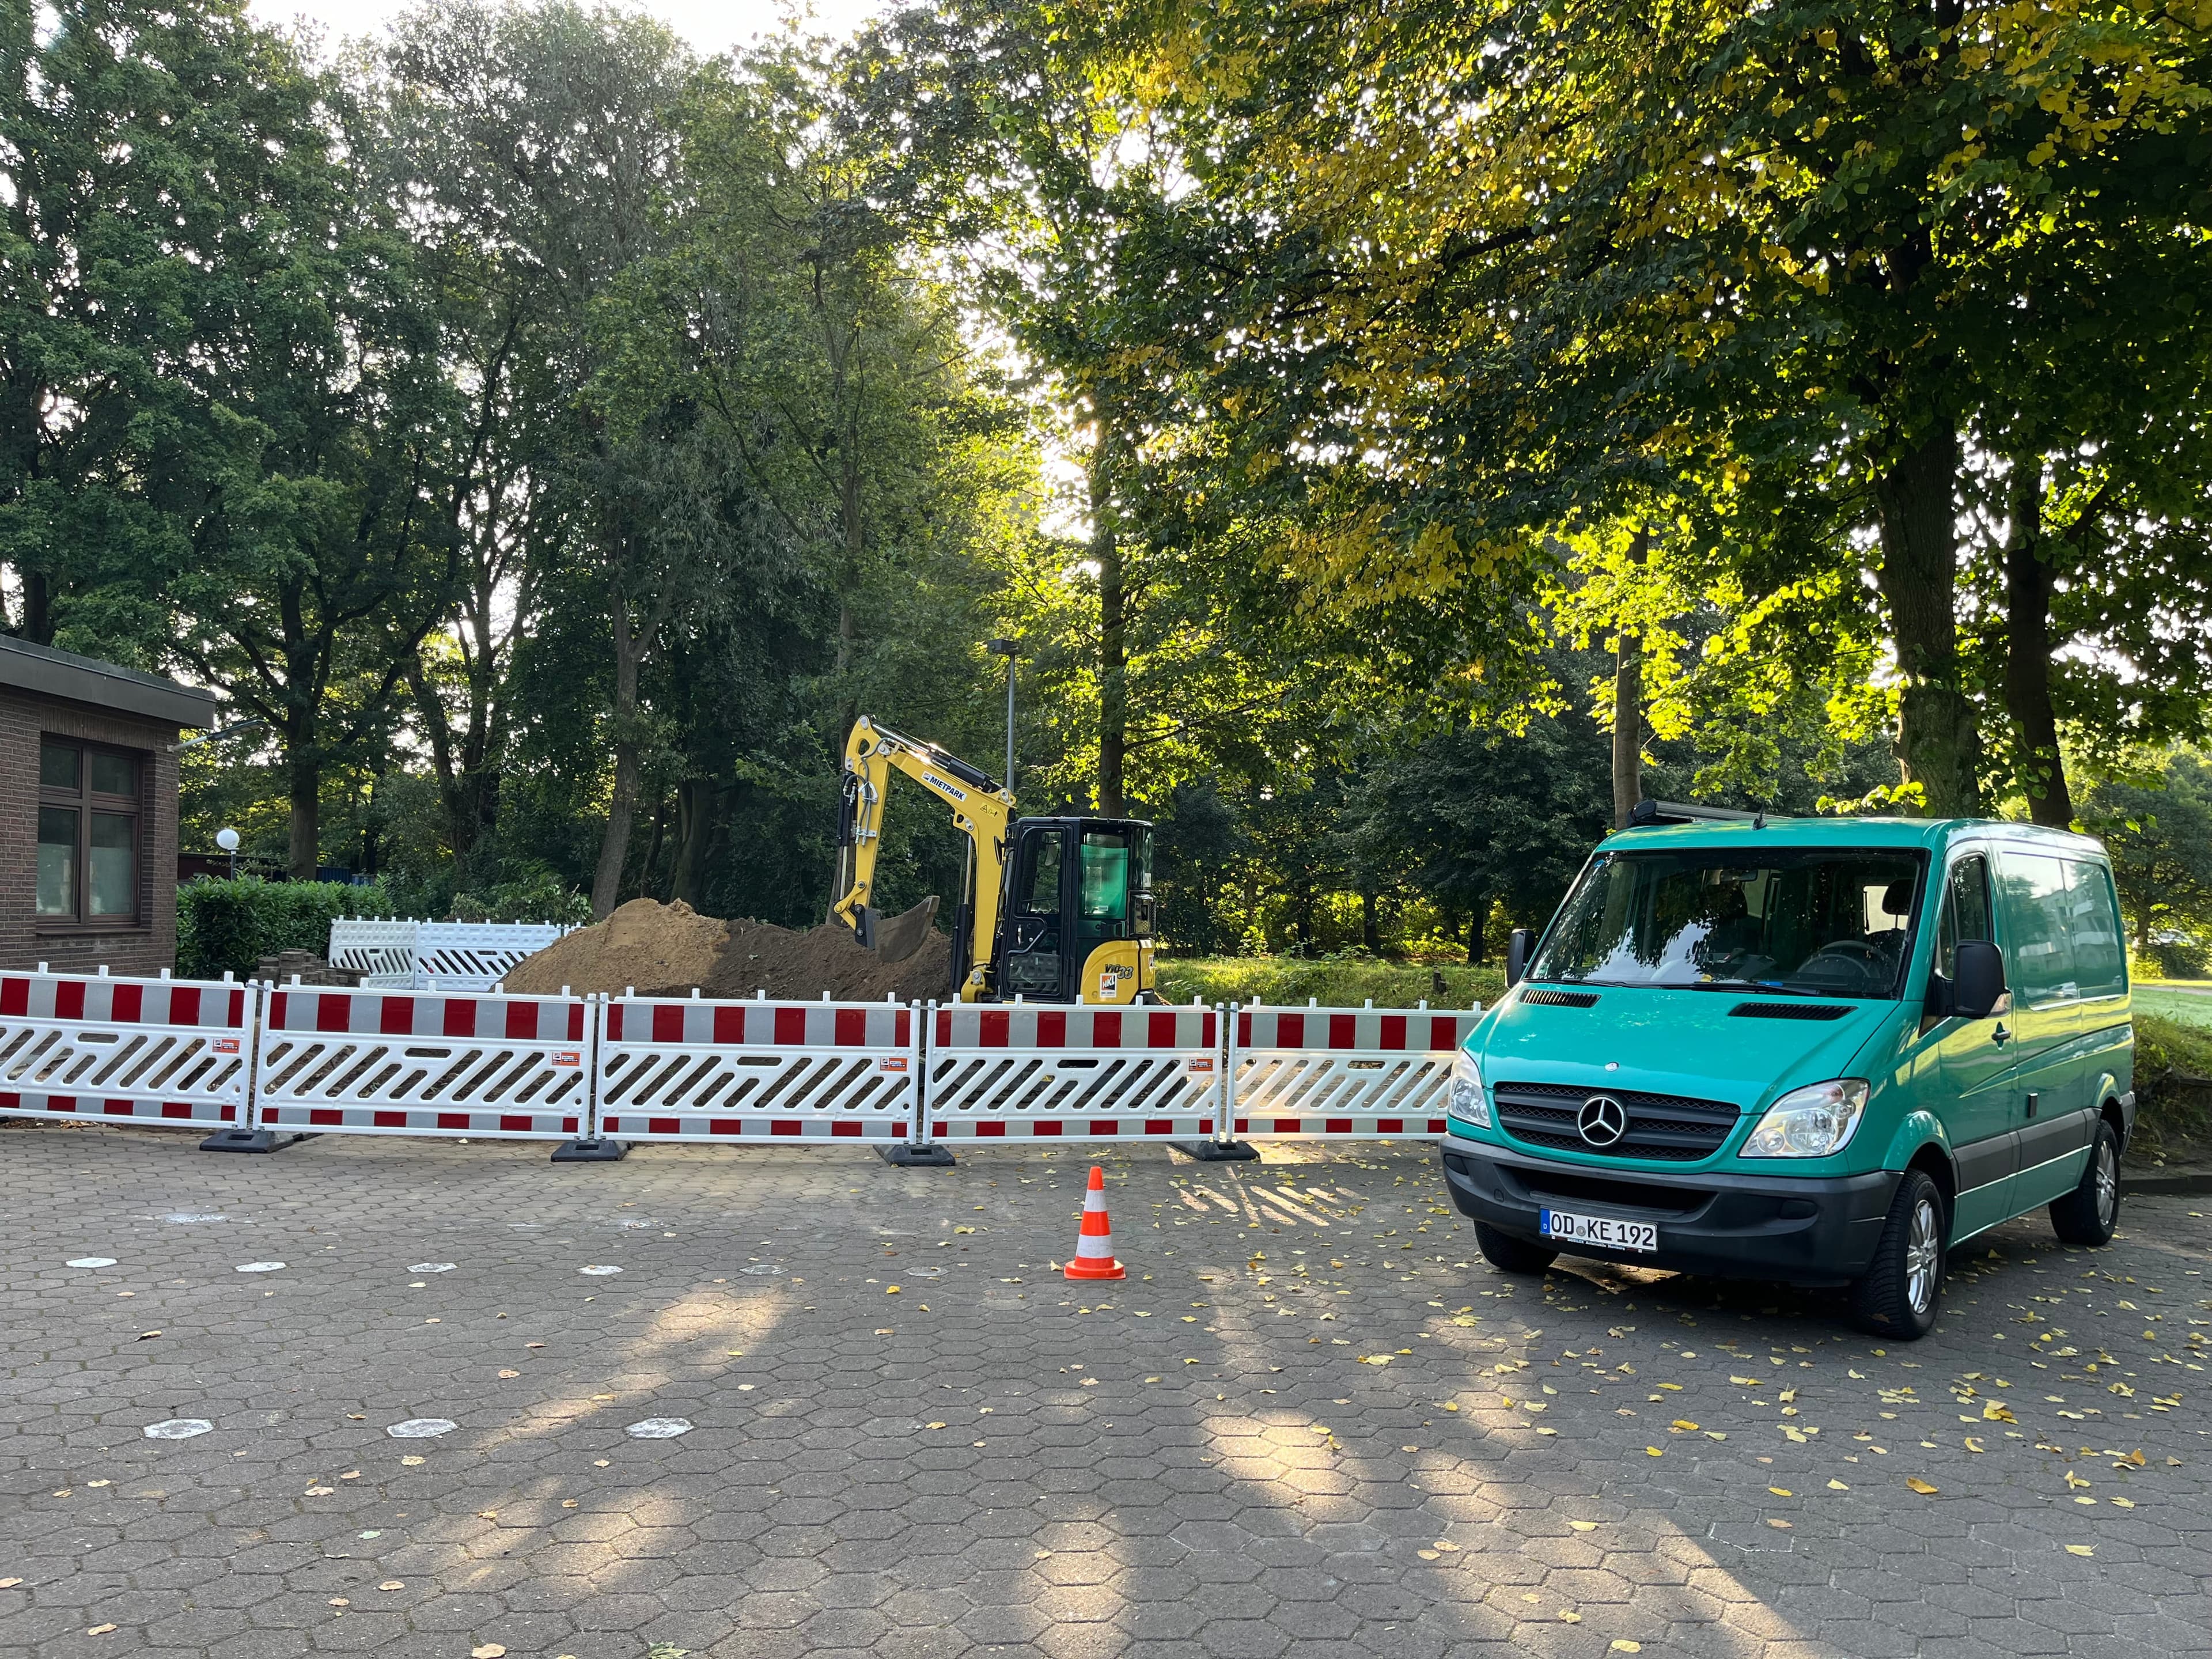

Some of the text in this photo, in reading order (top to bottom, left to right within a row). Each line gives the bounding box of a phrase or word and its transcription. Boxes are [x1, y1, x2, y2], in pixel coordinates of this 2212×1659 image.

[930, 776, 964, 800] MIETPARK
[1103, 975, 1115, 988] HKL
[1551, 1214, 1574, 1234] OD
[1587, 1219, 1612, 1241] KE
[1617, 1224, 1654, 1247] 192
